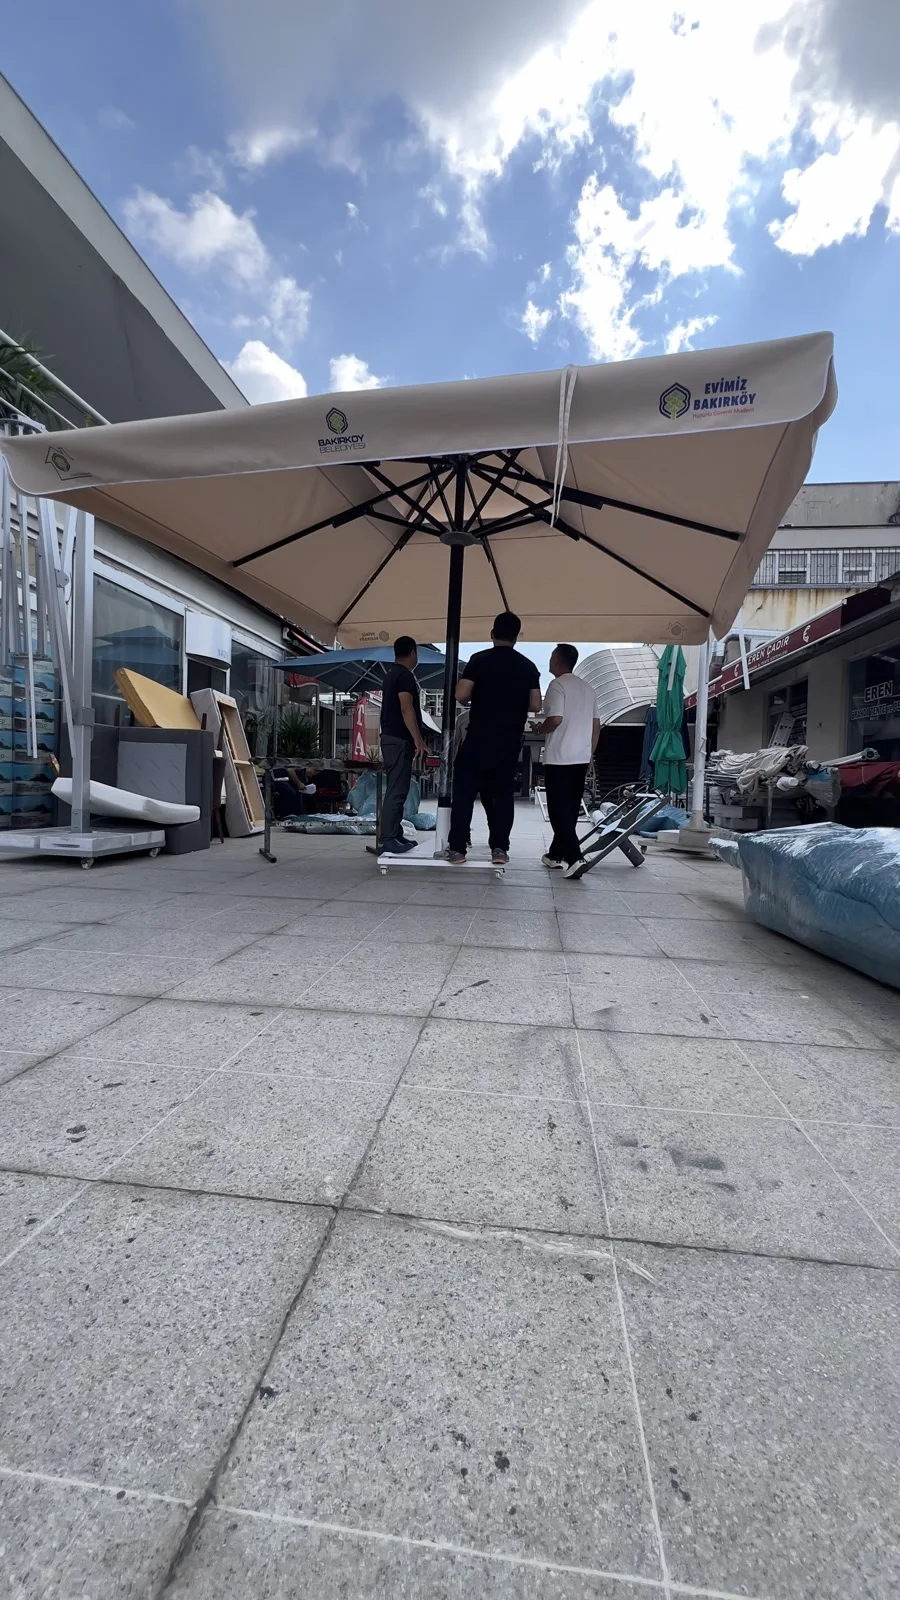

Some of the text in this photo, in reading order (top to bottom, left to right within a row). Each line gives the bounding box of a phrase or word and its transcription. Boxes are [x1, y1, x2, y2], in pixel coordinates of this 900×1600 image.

[704, 376, 747, 394] EVİMİZ
[693, 391, 756, 411] BAKIRKÖY
[748, 649, 766, 665] EREN
[767, 636, 790, 658] ÇADIR
[864, 680, 893, 702] EREN
[870, 704, 886, 717] TENTE
